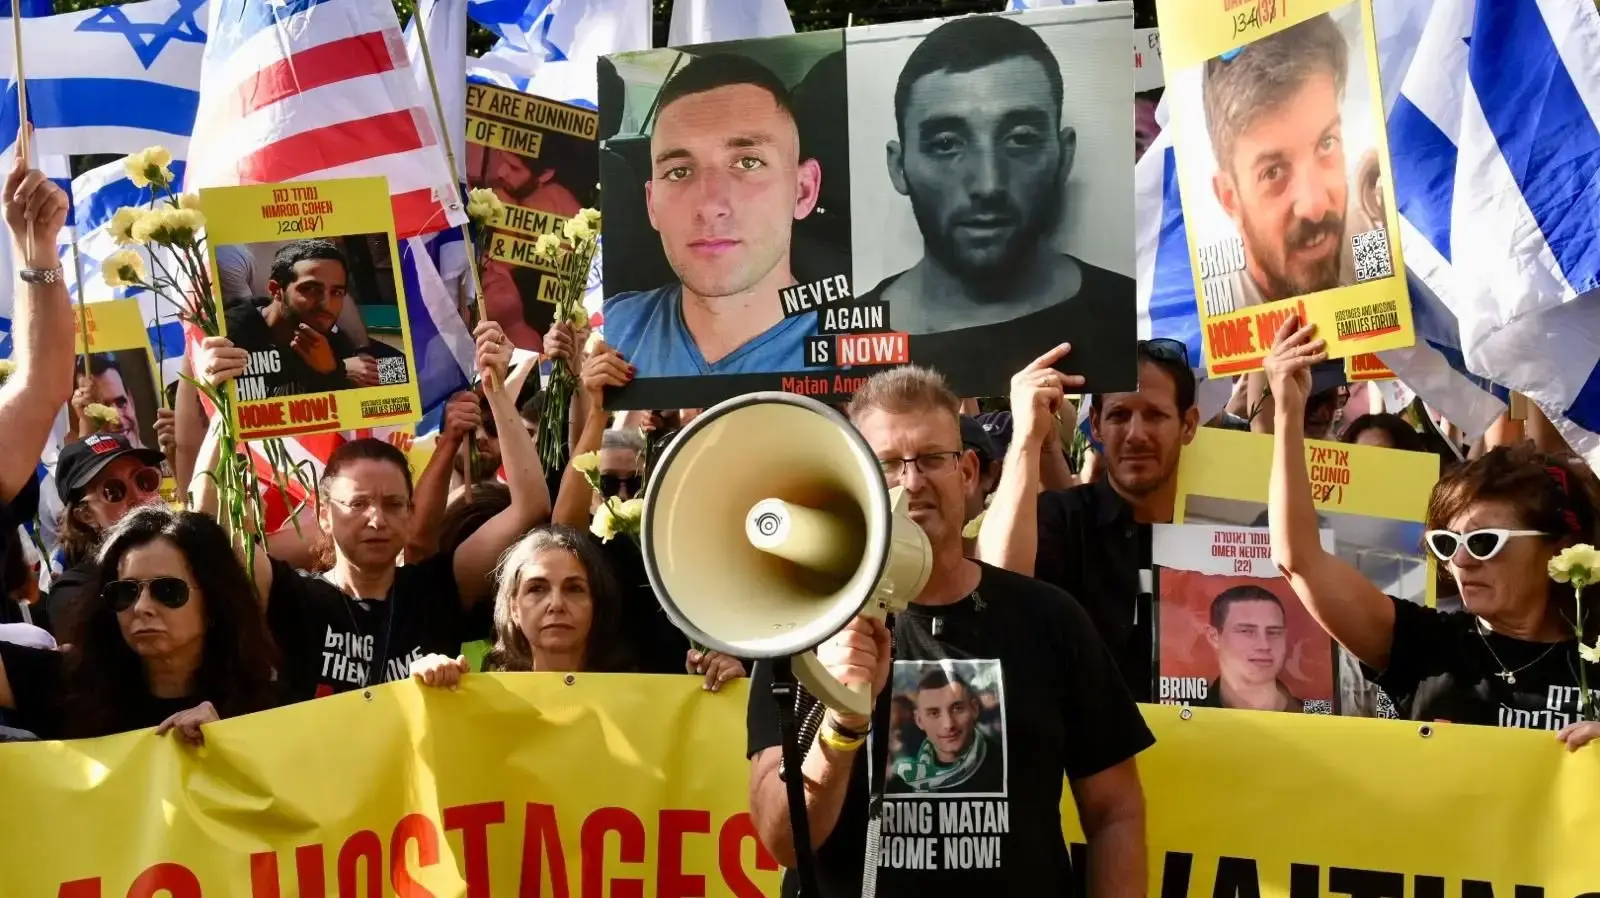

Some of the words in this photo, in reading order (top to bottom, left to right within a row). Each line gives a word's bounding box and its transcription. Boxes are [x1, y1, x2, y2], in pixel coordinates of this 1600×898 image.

[466, 86, 486, 108] EY
[488, 93, 521, 118] ARE
[524, 102, 596, 136] RUNNING
[475, 121, 497, 143] OF
[501, 126, 538, 154] TIME
[272, 188, 289, 204] כהן
[261, 203, 300, 219] NIMROD
[302, 200, 334, 216] COHEN
[504, 206, 548, 234] THEM
[493, 239, 506, 258] &
[1198, 237, 1246, 280] BRING
[782, 274, 852, 314] NEVER
[1203, 278, 1236, 318] HIM
[824, 306, 883, 331] AGAIN
[1334, 307, 1361, 321] HOSTAGES
[1361, 304, 1373, 316] AND
[1372, 300, 1397, 314] MISSING
[1207, 316, 1257, 360] HOME
[1255, 299, 1307, 351] NO!
[1336, 317, 1370, 338] FAMILIES
[1370, 311, 1399, 331] FORUM
[243, 349, 281, 375] RING
[811, 341, 829, 363] IS
[841, 336, 904, 364] NOW!
[234, 376, 267, 402] HIM
[781, 376, 829, 395] Matan
[833, 374, 868, 393] Ang
[237, 402, 286, 429] HOME
[288, 393, 338, 424] NOW!
[361, 404, 388, 418] FAMILIES
[389, 402, 411, 414] FORUM
[1309, 446, 1349, 467] אריאל
[1311, 465, 1350, 485] CUNIO
[1211, 545, 1237, 557] OMER
[1234, 559, 1252, 573] (22)
[321, 651, 372, 688] THEM
[385, 645, 424, 684] OME
[1160, 676, 1208, 700] BRING
[882, 801, 933, 834] RING
[938, 801, 1010, 834] MATAN
[877, 835, 938, 870] HOME
[943, 836, 1001, 870] NOW!
